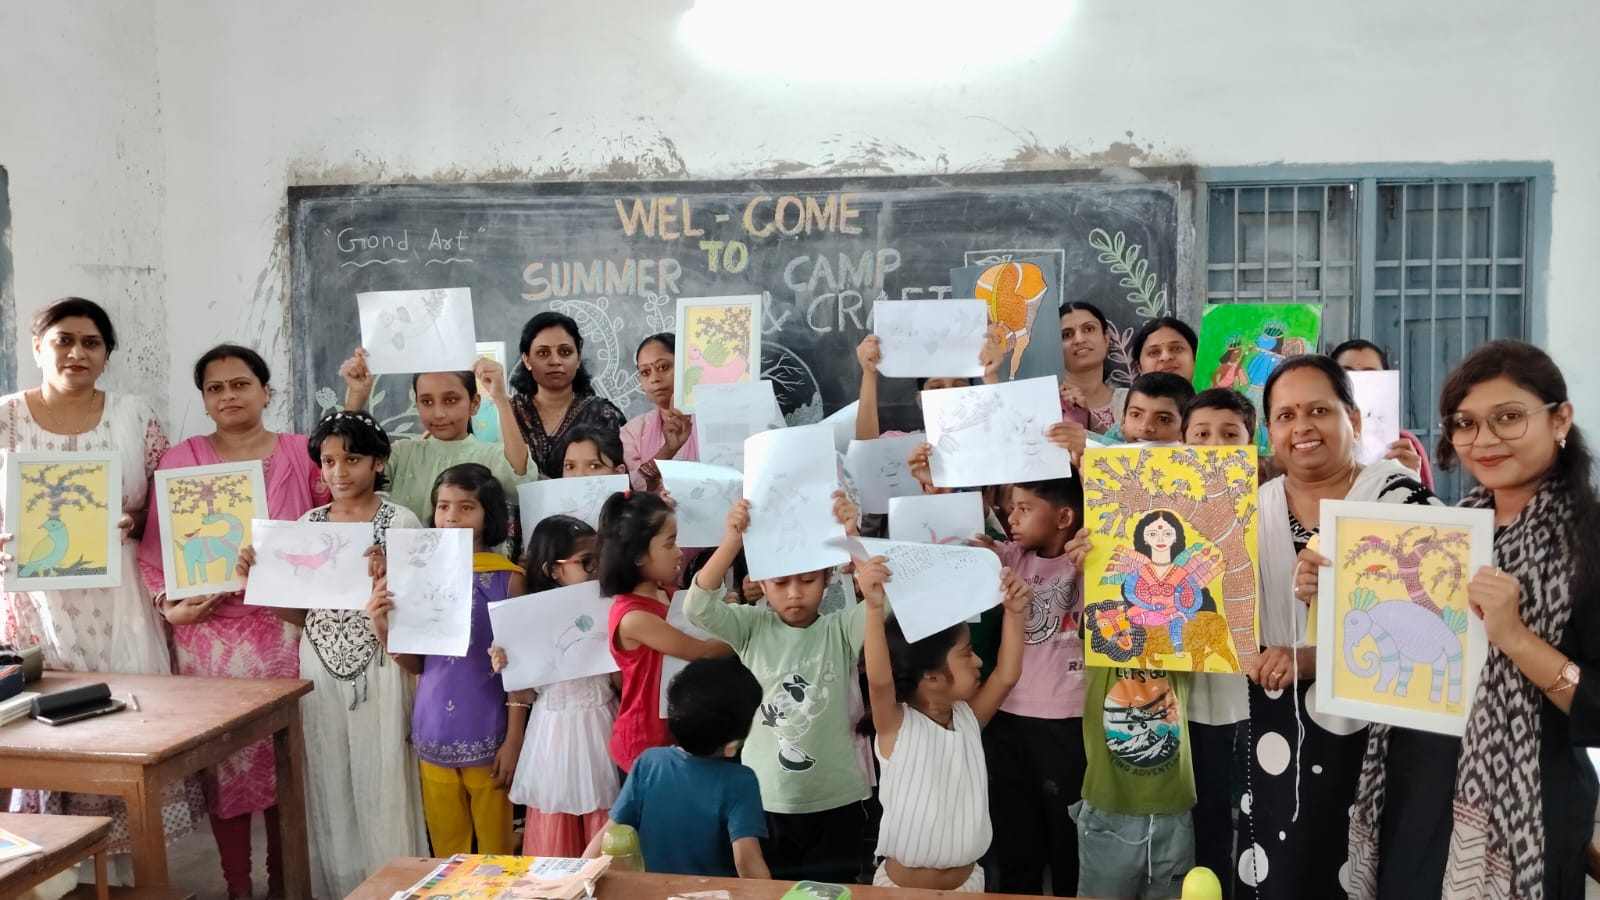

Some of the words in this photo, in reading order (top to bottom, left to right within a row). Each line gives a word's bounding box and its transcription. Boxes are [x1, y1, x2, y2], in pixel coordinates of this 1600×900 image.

[614, 197, 704, 240] WEL
[743, 193, 863, 238] COME
[521, 257, 682, 301] SUMMER
[698, 240, 748, 274] TO
[783, 248, 901, 292] CAMP
[761, 289, 792, 335] &
